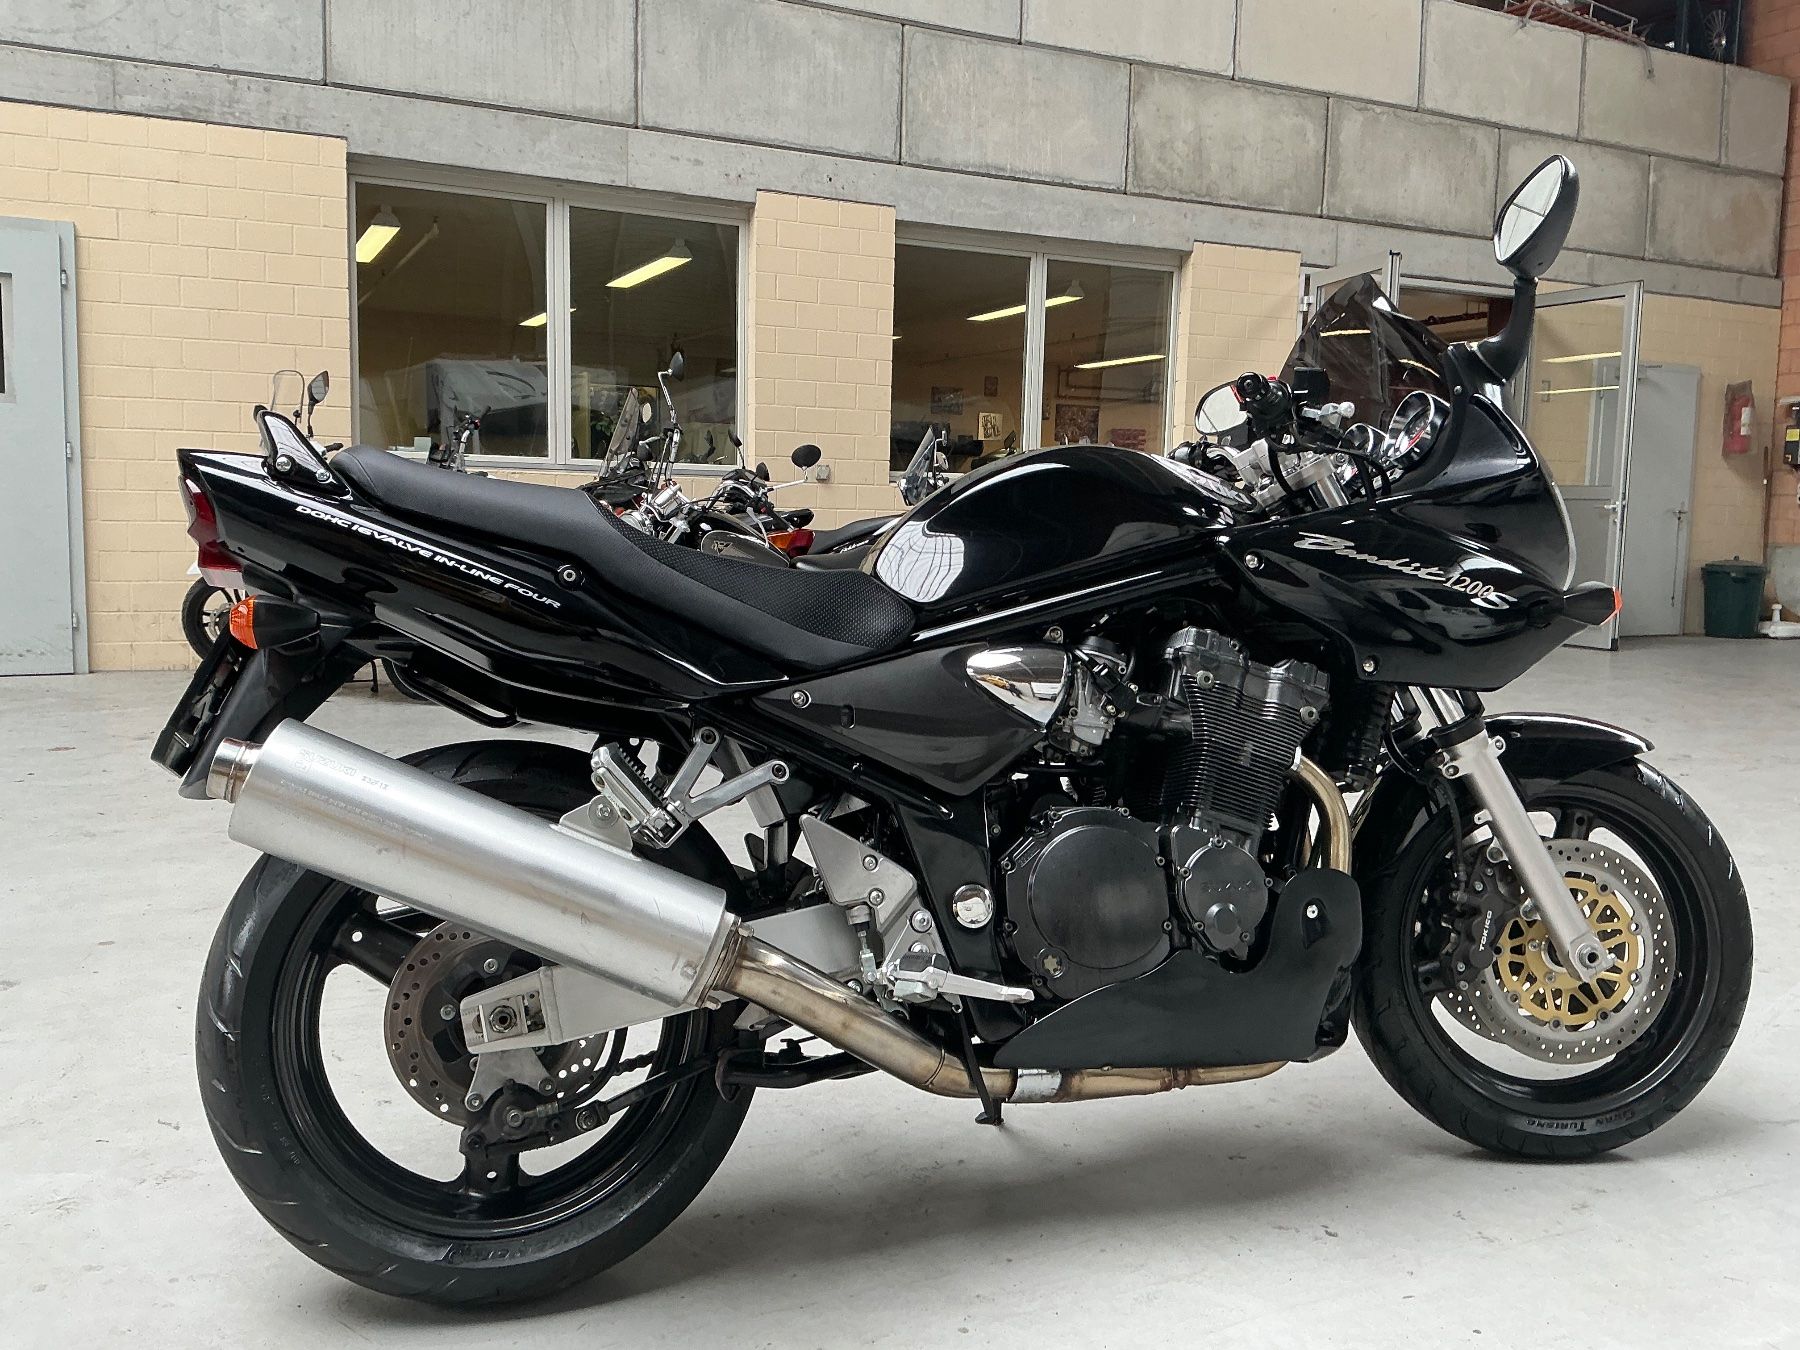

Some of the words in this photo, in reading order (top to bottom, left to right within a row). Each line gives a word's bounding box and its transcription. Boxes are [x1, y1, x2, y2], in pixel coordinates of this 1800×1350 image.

[295, 504, 351, 528] DOHC
[433, 555, 505, 586] IN-LINE
[503, 582, 561, 609] FOUR
[1293, 531, 1447, 581] Bandit
[1479, 910, 1492, 951] TOKICO
